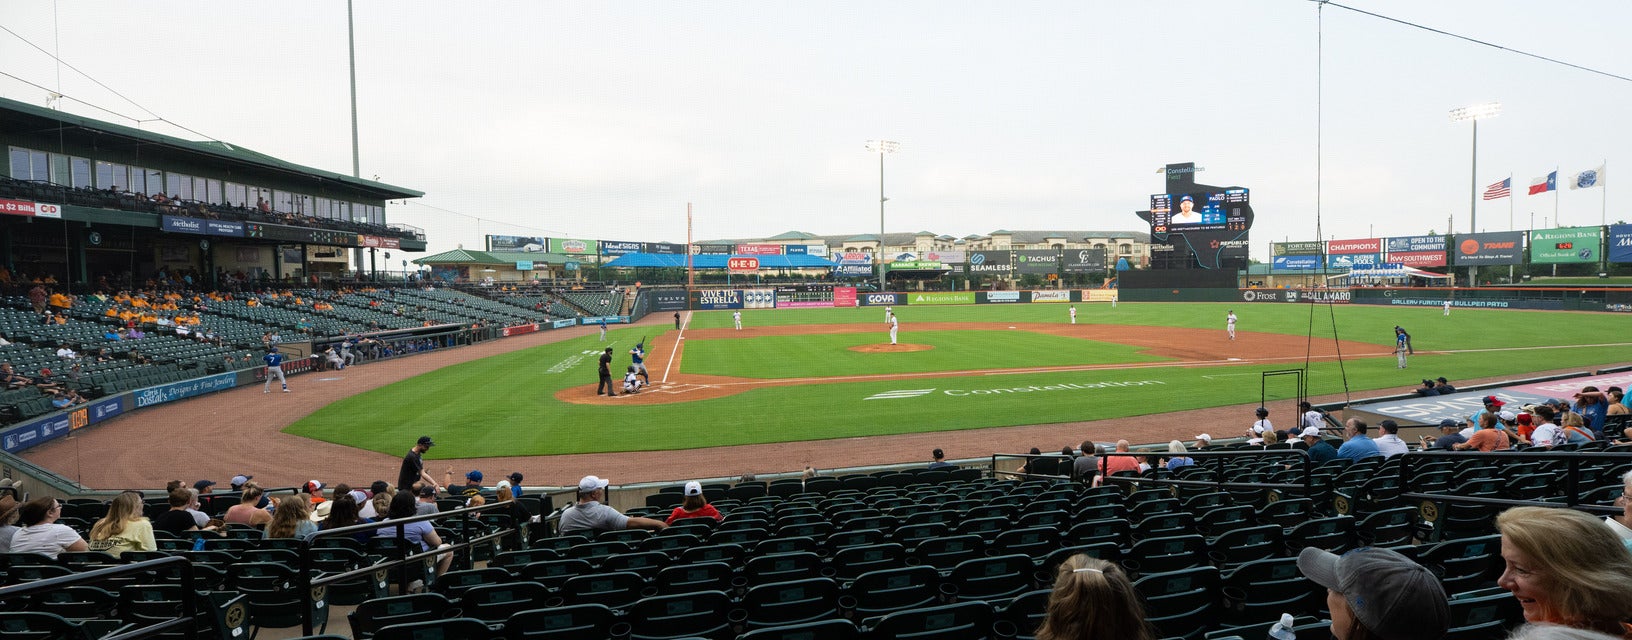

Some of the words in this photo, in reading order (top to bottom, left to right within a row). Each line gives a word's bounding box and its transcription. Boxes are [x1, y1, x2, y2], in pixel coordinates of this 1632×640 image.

[18, 204, 35, 213] Bills
[1410, 243, 1445, 251] COMMUNITY
[1404, 254, 1443, 262] SOUTHWEST
[971, 264, 1011, 272] SEAMLESS
[700, 296, 739, 304] ESTRELLA
[868, 294, 895, 304] GOYA
[1256, 292, 1277, 300] Frost
[168, 385, 192, 397] Designs
[192, 383, 199, 391] &
[199, 380, 213, 390] Fine
[213, 376, 236, 389] Jewelry
[943, 378, 1167, 397] Constellation
[143, 389, 159, 397] Chris
[137, 389, 168, 407] Dostal's
